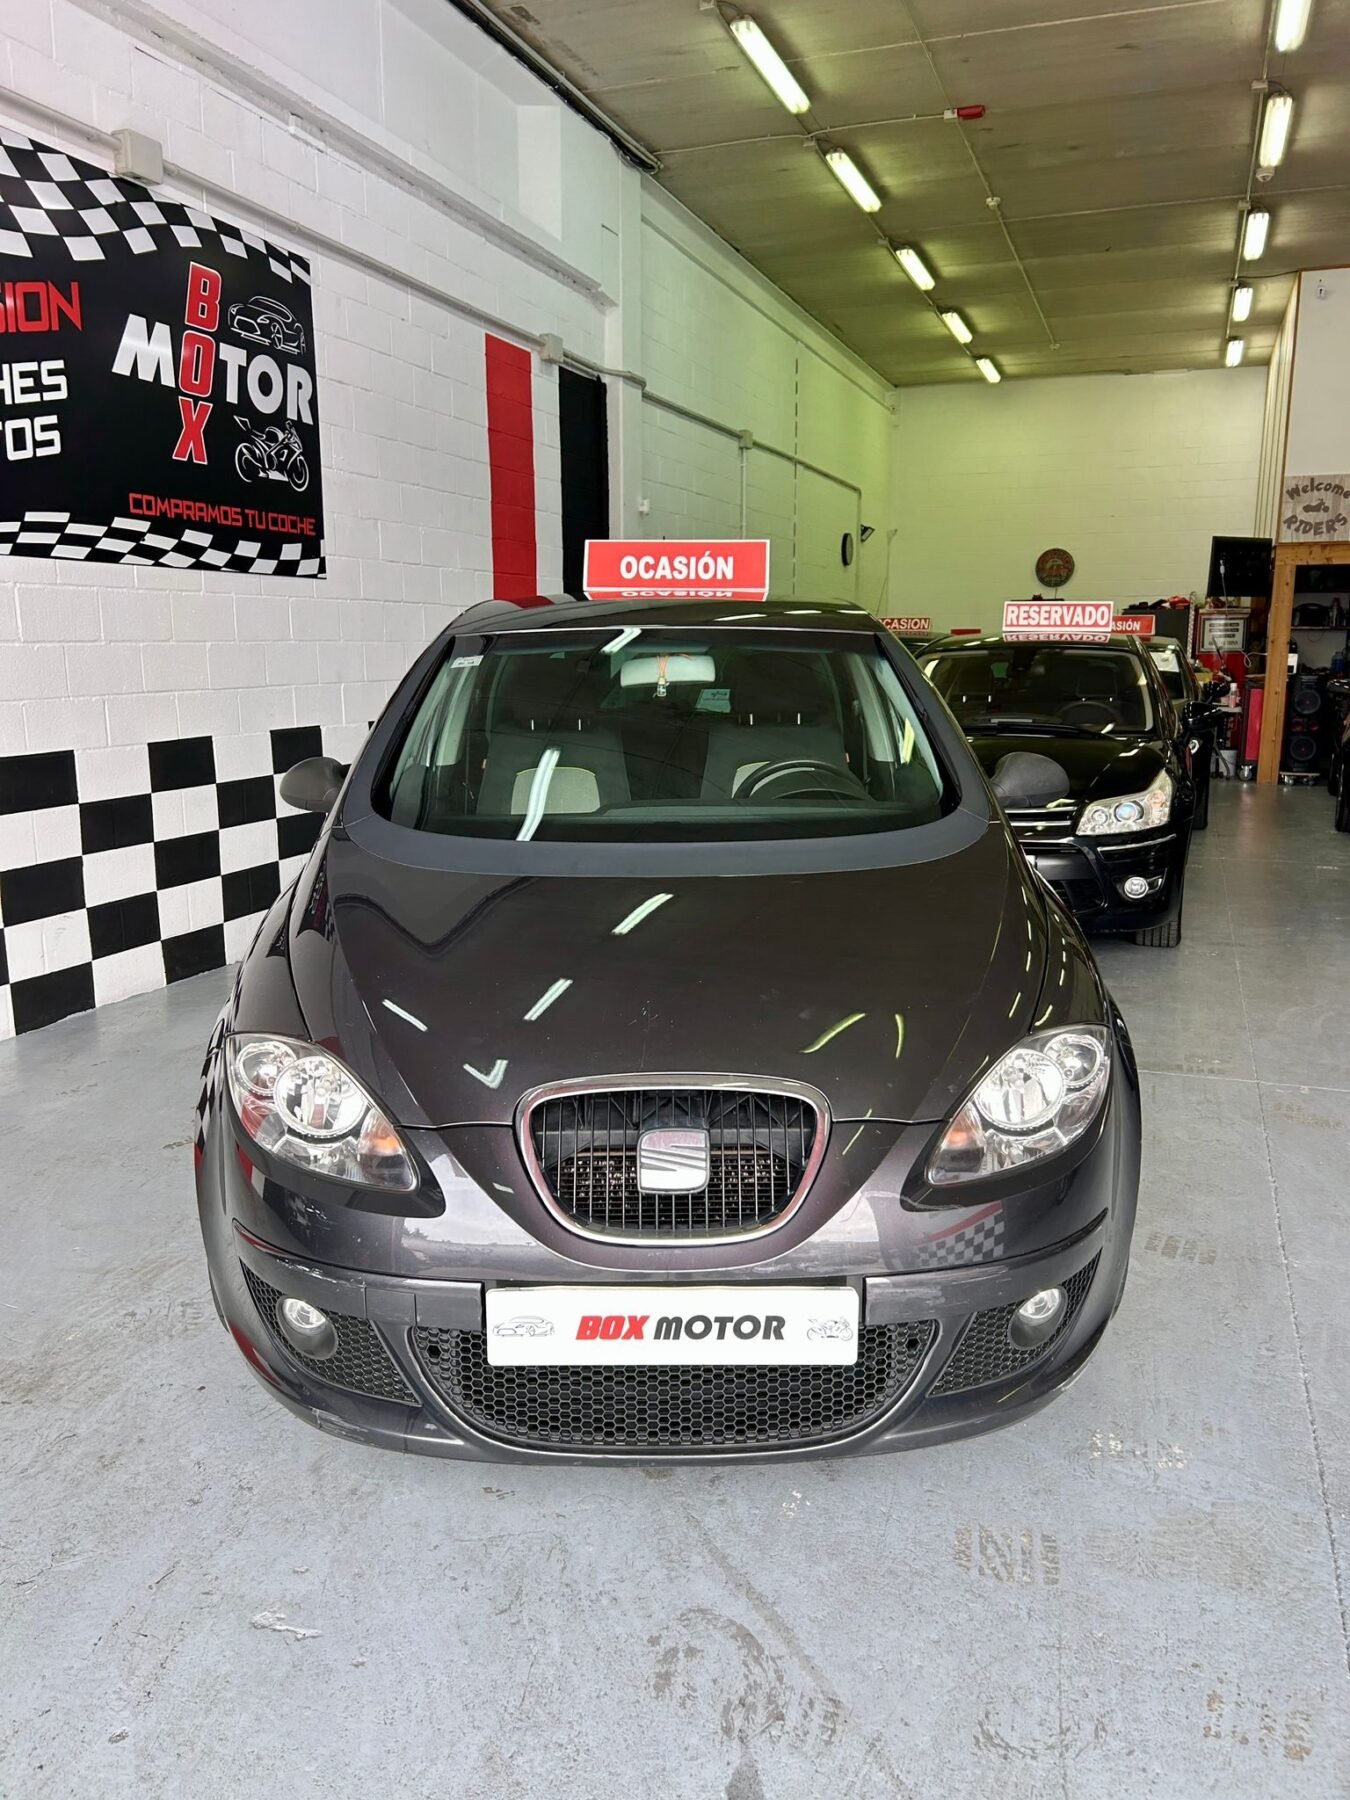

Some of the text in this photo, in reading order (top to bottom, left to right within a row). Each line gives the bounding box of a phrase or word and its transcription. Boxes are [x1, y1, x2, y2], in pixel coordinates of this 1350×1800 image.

[0, 280, 82, 333] ION
[111, 313, 313, 425] MOTOR
[172, 261, 222, 465] BOX
[0, 415, 61, 461] OS
[1286, 477, 1350, 500] Welcome
[129, 493, 316, 536] COMPRAMOS TU COCHE
[619, 551, 734, 580] OCASIÓN
[1006, 606, 1109, 625] RESERVADO
[576, 1315, 786, 1340] BOX MOTOR
